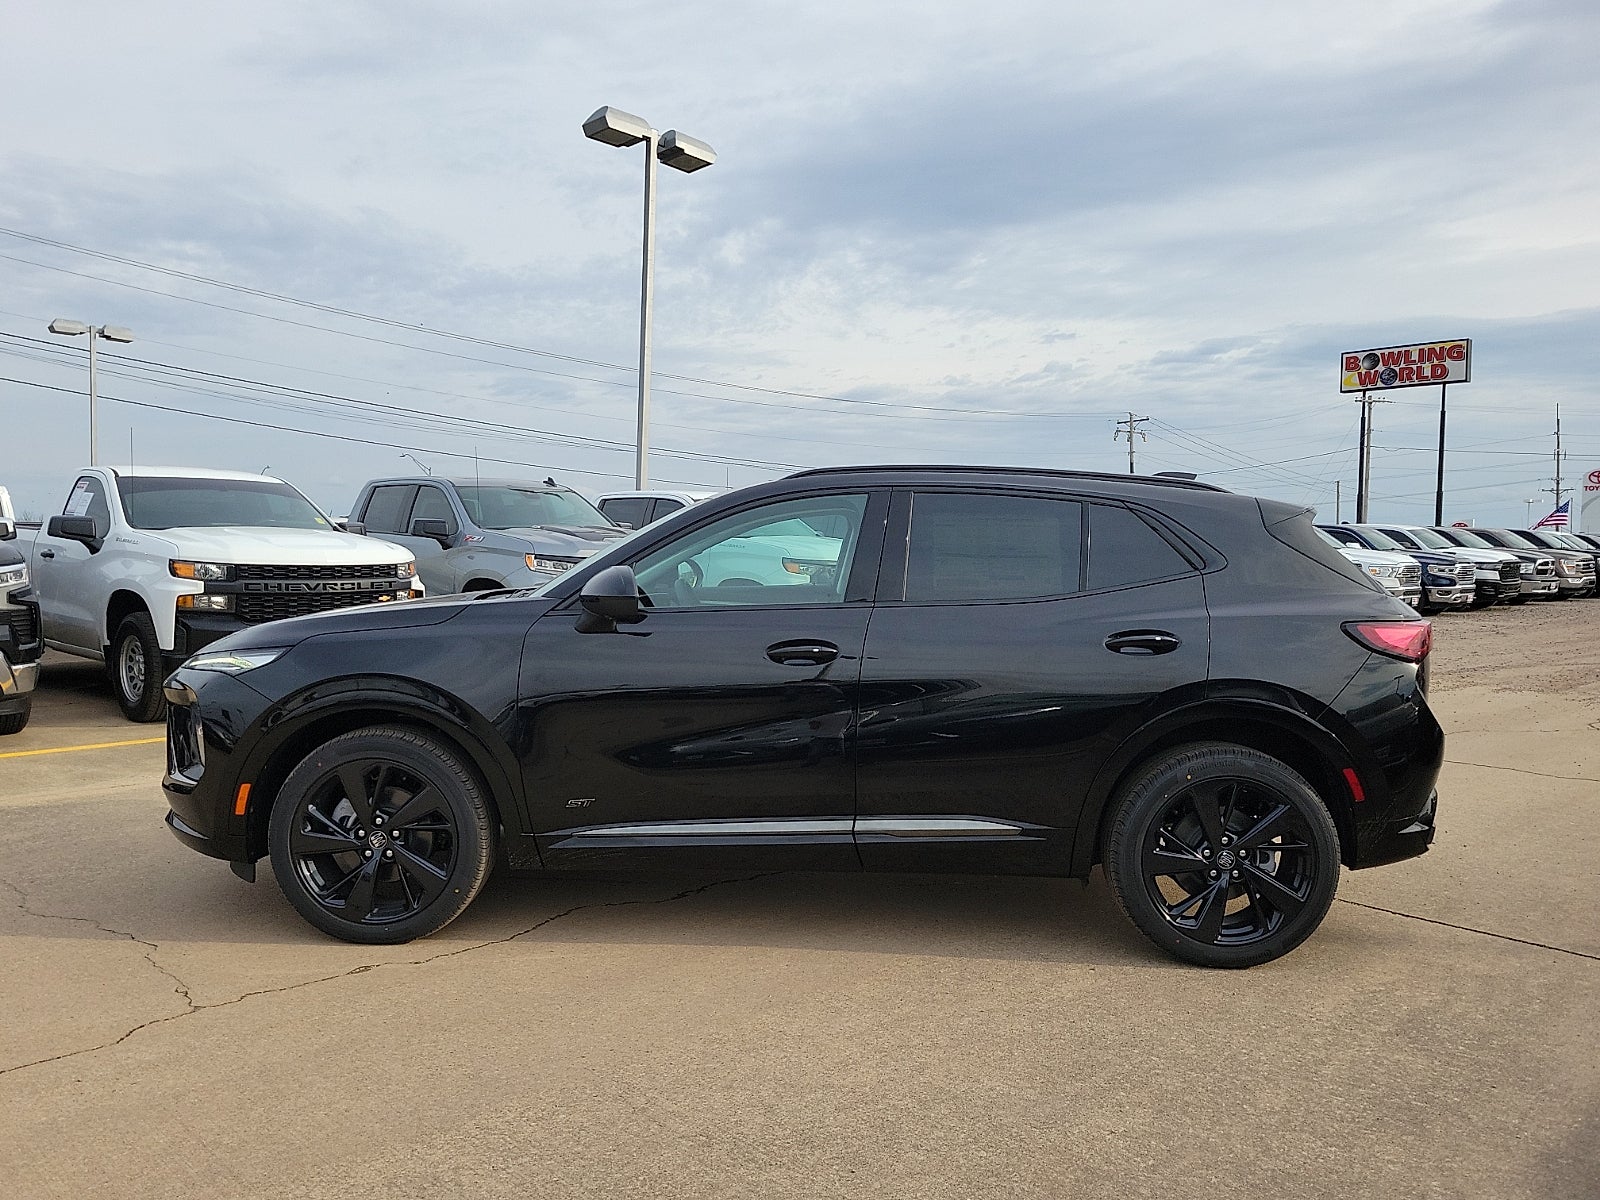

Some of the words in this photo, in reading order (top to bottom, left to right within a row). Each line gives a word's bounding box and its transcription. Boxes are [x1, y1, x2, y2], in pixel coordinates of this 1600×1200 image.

[1345, 344, 1465, 372] BOWLING
[1357, 363, 1449, 387] WORLD
[243, 580, 397, 592] CHEVROLET
[565, 798, 596, 807] ST
